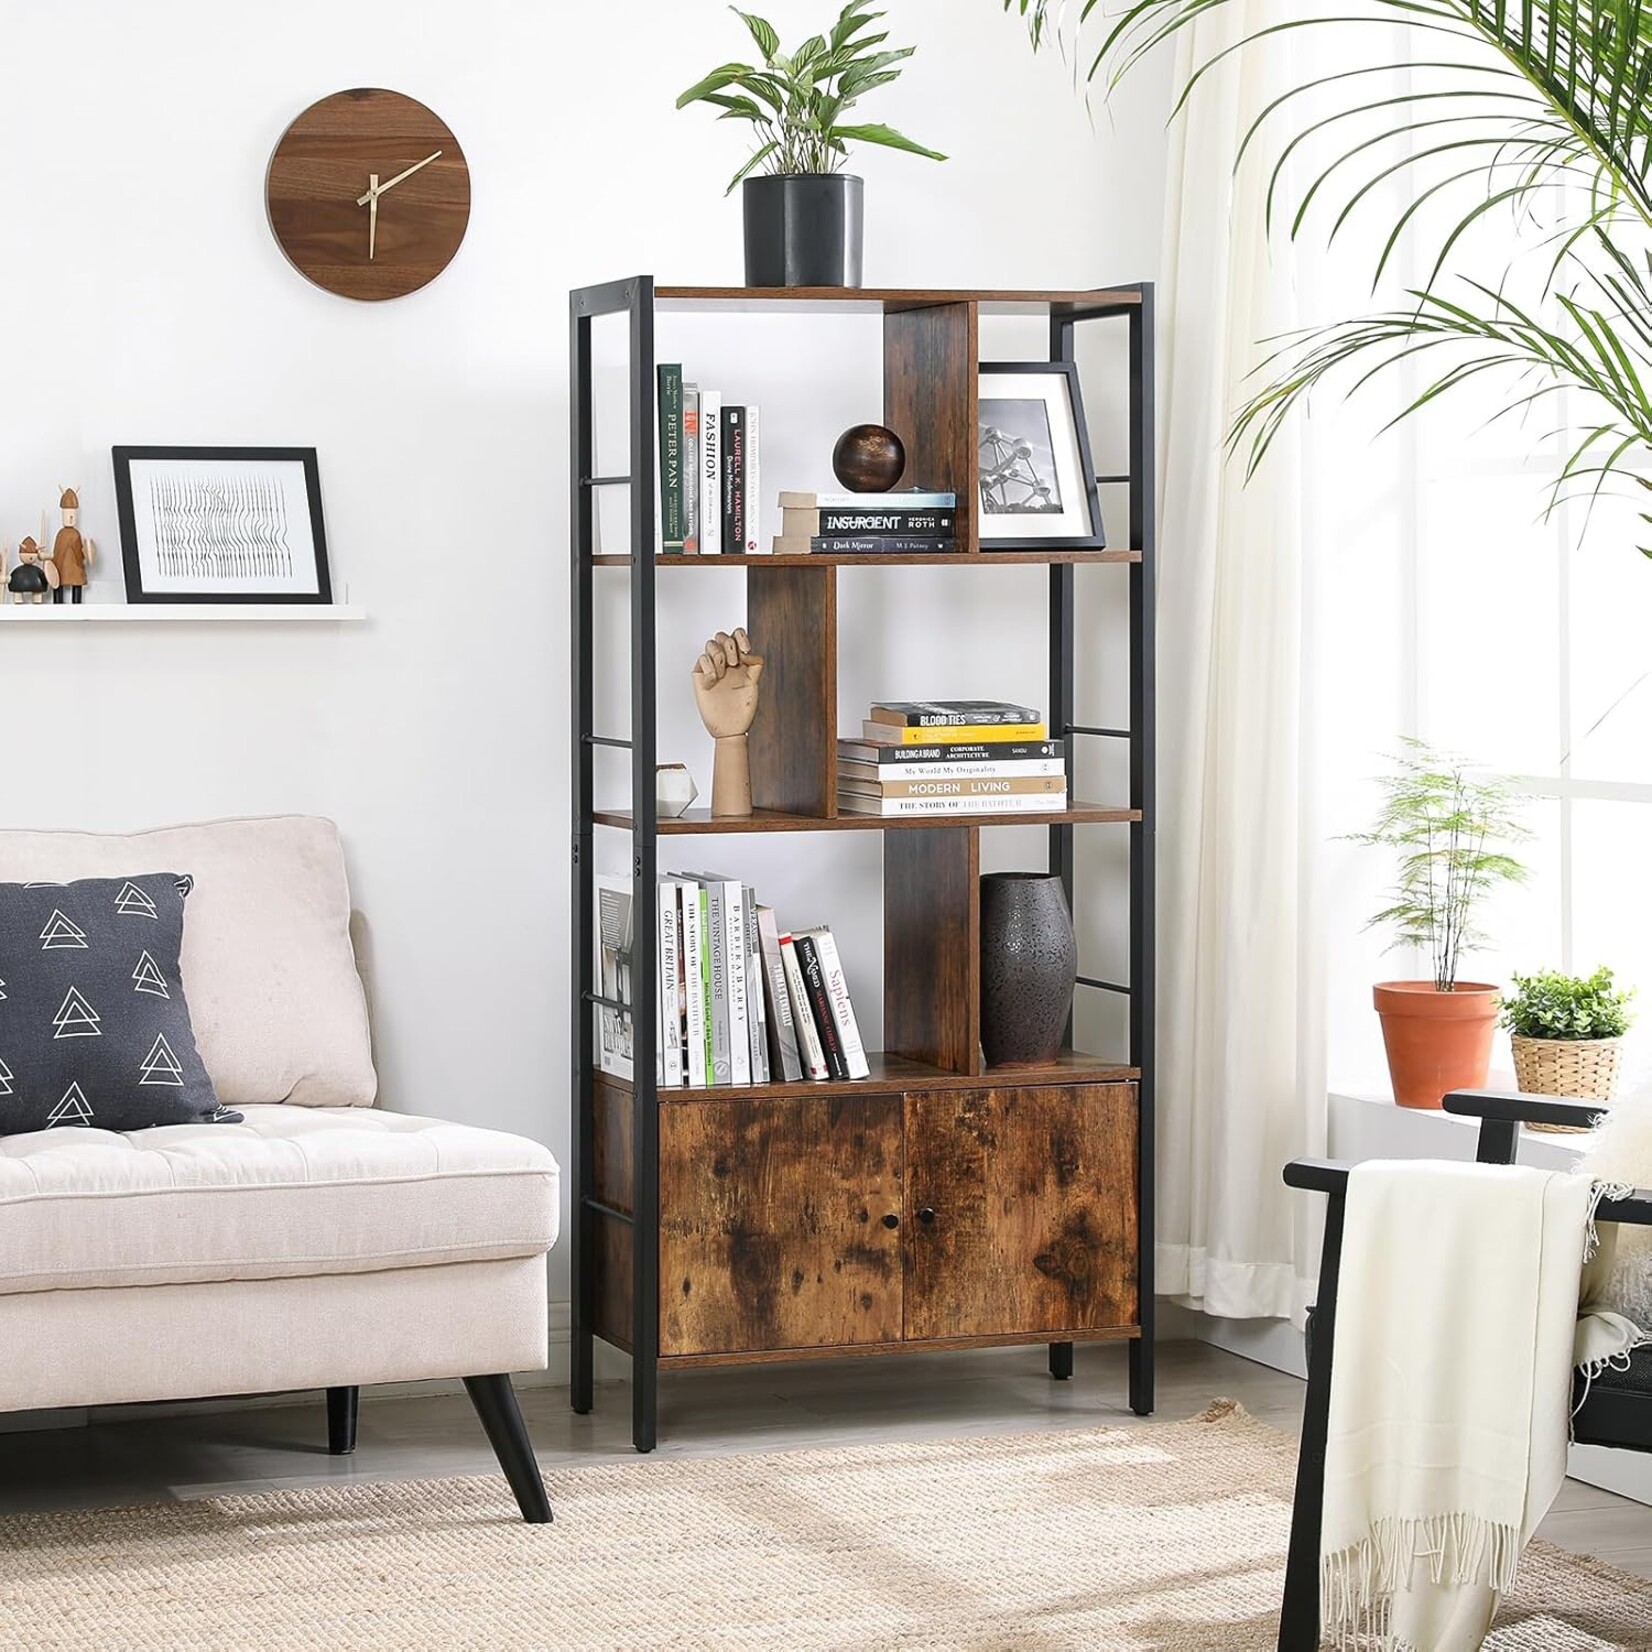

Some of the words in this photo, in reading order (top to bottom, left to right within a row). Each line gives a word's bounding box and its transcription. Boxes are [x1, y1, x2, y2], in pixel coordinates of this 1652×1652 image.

[668, 414, 678, 457] PETER
[705, 413, 716, 480] FASHION
[734, 429, 742, 474] LAURELL
[668, 460, 678, 488] PAN
[735, 477, 742, 488] K.
[734, 491, 742, 541] HAMILTON
[827, 516, 901, 530] INSURGENT
[833, 541, 851, 550] Dark
[852, 541, 874, 551] Mirror
[920, 715, 946, 727] BLOOD
[947, 714, 966, 726] TIES
[909, 783, 960, 794] MODERN
[970, 782, 1010, 792] LIVING
[900, 802, 917, 810] THE
[948, 801, 959, 809] OF
[712, 897, 720, 918] THE
[664, 910, 674, 945] GREAT
[689, 923, 697, 953] STORY
[713, 920, 721, 965] VINTAGE
[665, 947, 675, 990] BRITAIN
[691, 956, 697, 969] OF
[803, 942, 811, 961] THE
[807, 956, 820, 988] NAMED
[713, 965, 722, 1000] HOUSE
[829, 969, 851, 1027] Sapiens
